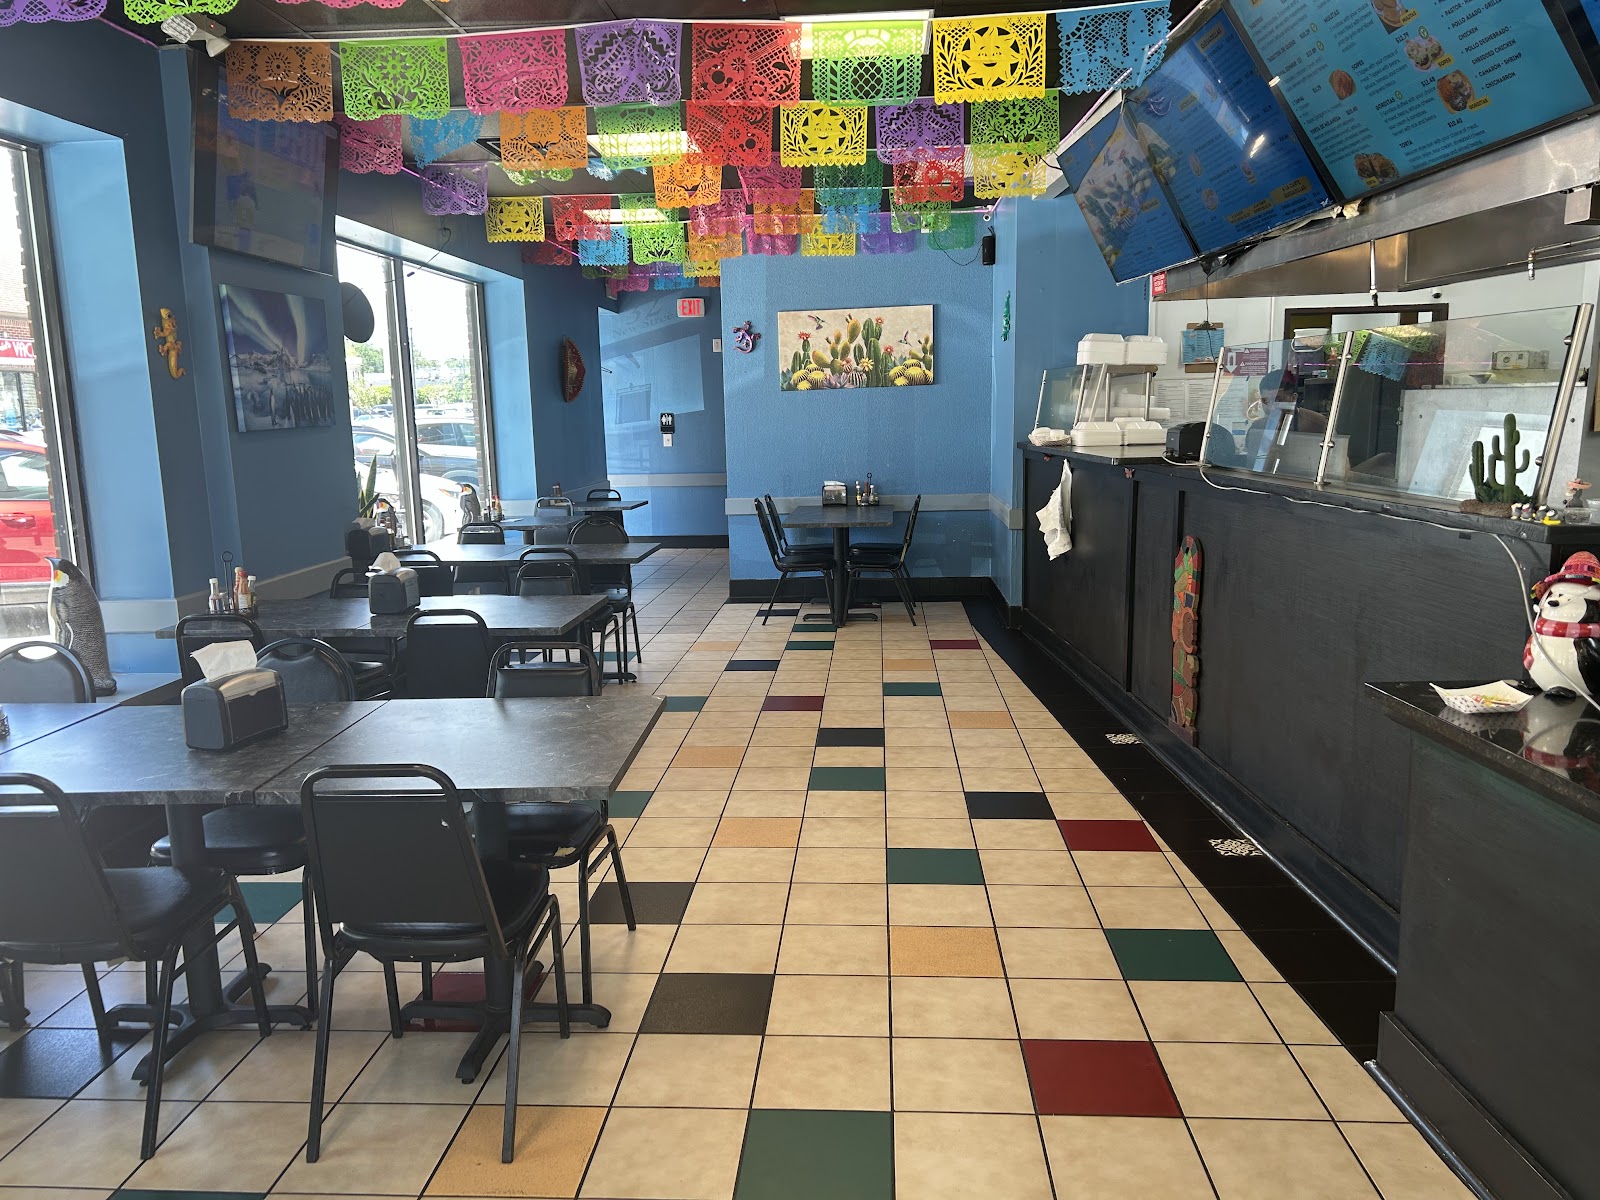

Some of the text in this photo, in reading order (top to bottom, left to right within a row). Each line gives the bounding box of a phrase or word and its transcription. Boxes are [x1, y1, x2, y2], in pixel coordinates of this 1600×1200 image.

[1445, 3, 1462, 15] PASTOR
[1323, 10, 1340, 22] MULITAS
[1402, 11, 1417, 22] MULITAS
[1452, 18, 1466, 28] POLLO
[1466, 8, 1482, 20] ASADO
[1458, 27, 1478, 40] CHICKEN
[1465, 27, 1510, 52] POLLO DESHEBRADO
[1472, 40, 1516, 64] SHREDDED CHICKEN
[1504, 52, 1522, 64] SHRIMP
[1351, 60, 1364, 70] SOPES
[1438, 57, 1451, 67] SOPES
[1375, 97, 1395, 110] GORDITAS
[1469, 98, 1488, 110] GORDITAS
[1400, 140, 1412, 148] TORTA
[681, 299, 701, 316] EXIT
